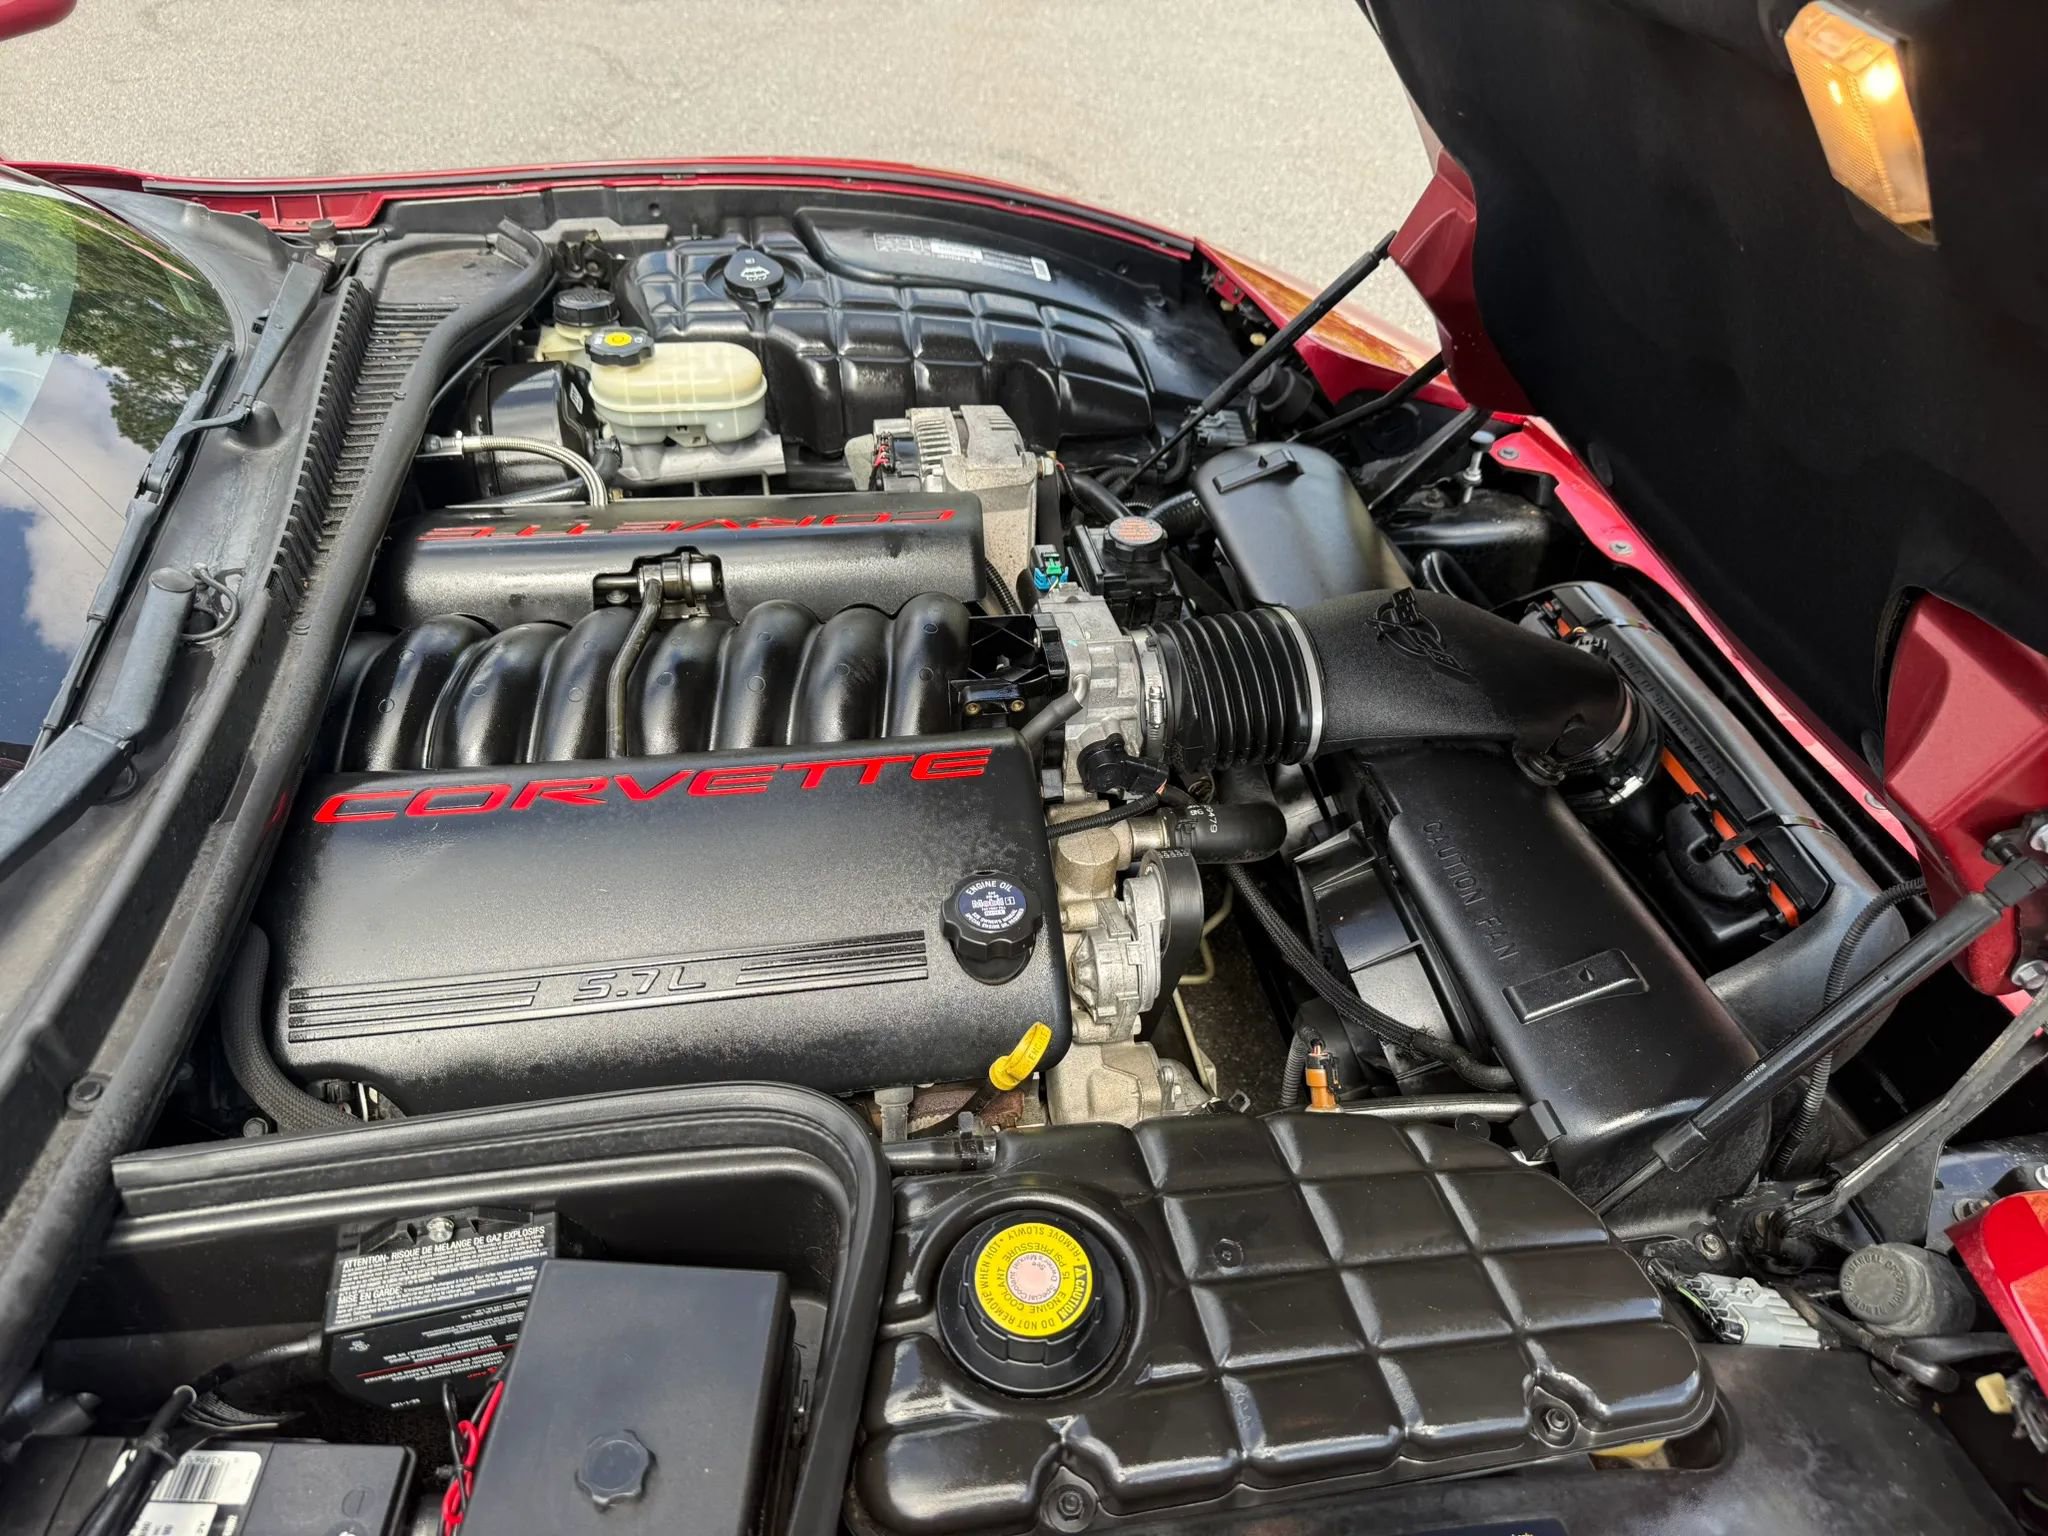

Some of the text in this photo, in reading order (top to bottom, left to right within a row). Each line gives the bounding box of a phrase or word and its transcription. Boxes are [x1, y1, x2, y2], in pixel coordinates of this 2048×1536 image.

[416, 509, 956, 541] CORVETTE
[314, 748, 993, 824] CORVETTE
[965, 880, 997, 895] ENGINE
[1000, 881, 1013, 892] OIL
[971, 897, 1005, 908] Mobil
[1423, 821, 1519, 960] CAUTION FAN
[573, 966, 708, 1002] 5.7L
[1028, 1028, 1049, 1061] ENGINE
[391, 1247, 420, 1260] RISQUE
[421, 1245, 432, 1254] DE
[473, 1236, 484, 1246] DE
[486, 1232, 502, 1243] GAZ
[503, 1226, 546, 1240] EXPLOSIFS
[1008, 1226, 1081, 1257] REMOVE SLOWLY
[1002, 1242, 1070, 1280] 15 PSI PRESSURE
[1848, 1254, 1882, 1273] MANUAL
[339, 1293, 358, 1302] MISE
[360, 1292, 371, 1300] EN
[980, 1241, 1055, 1331] DO NOT REMOVE WHEN HOT
[997, 1266, 1066, 1313] ENGINE COOLANT
[1010, 1270, 1057, 1300] Special Coolant
[1058, 1279, 1086, 1319] CAUTION
[1843, 1274, 1854, 1292] FOR
[1885, 1260, 1905, 1308] OPERATION
